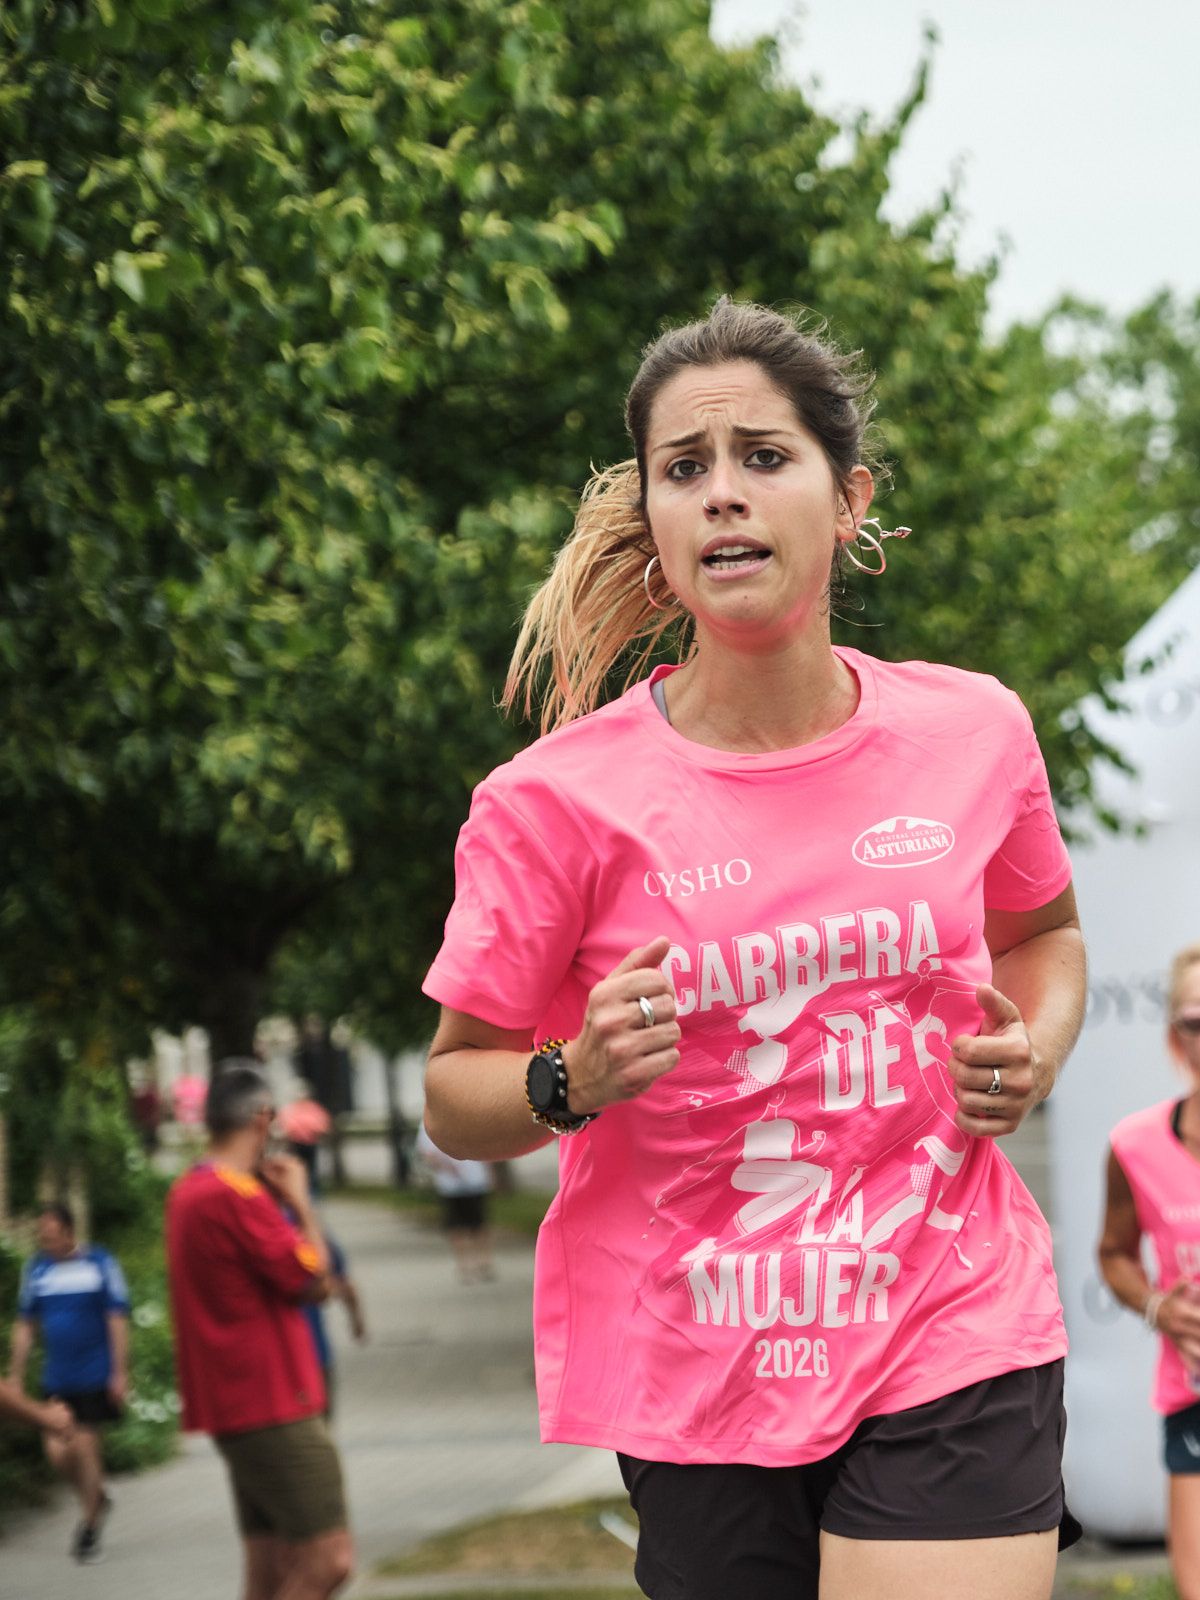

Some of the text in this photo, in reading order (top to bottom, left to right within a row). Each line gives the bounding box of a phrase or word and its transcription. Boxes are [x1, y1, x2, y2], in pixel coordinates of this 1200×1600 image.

[643, 858, 751, 897] OYSHO
[862, 834, 950, 860] ASTURIANA
[660, 900, 943, 1017] CARRERA
[818, 1002, 906, 1111] DE
[794, 1164, 867, 1244] LA
[683, 1247, 901, 1330] MUJER
[755, 1337, 830, 1378] 2026
